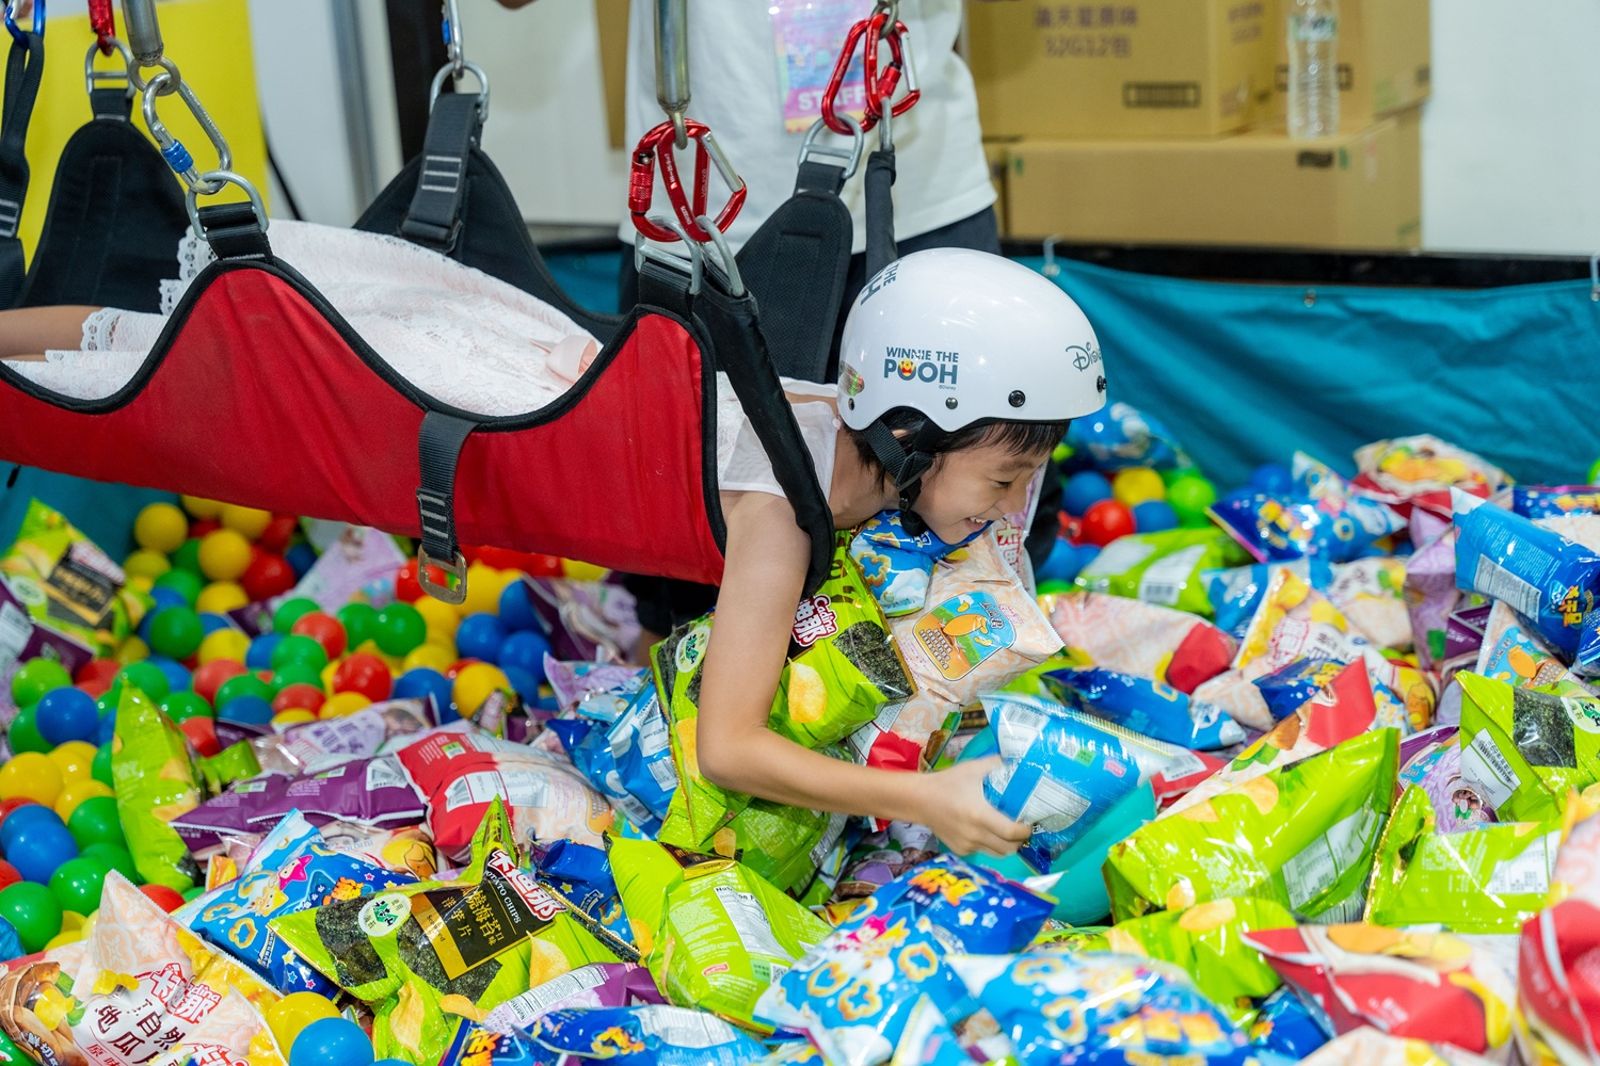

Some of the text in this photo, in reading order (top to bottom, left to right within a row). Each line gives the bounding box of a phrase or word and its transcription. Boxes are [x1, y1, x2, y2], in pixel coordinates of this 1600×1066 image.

[886, 346, 959, 363] WINNIE THE
[883, 358, 958, 385] POOH
[813, 596, 836, 634] Cadina
[503, 896, 521, 923] CHIPS
[136, 1011, 186, 1051] 自然
